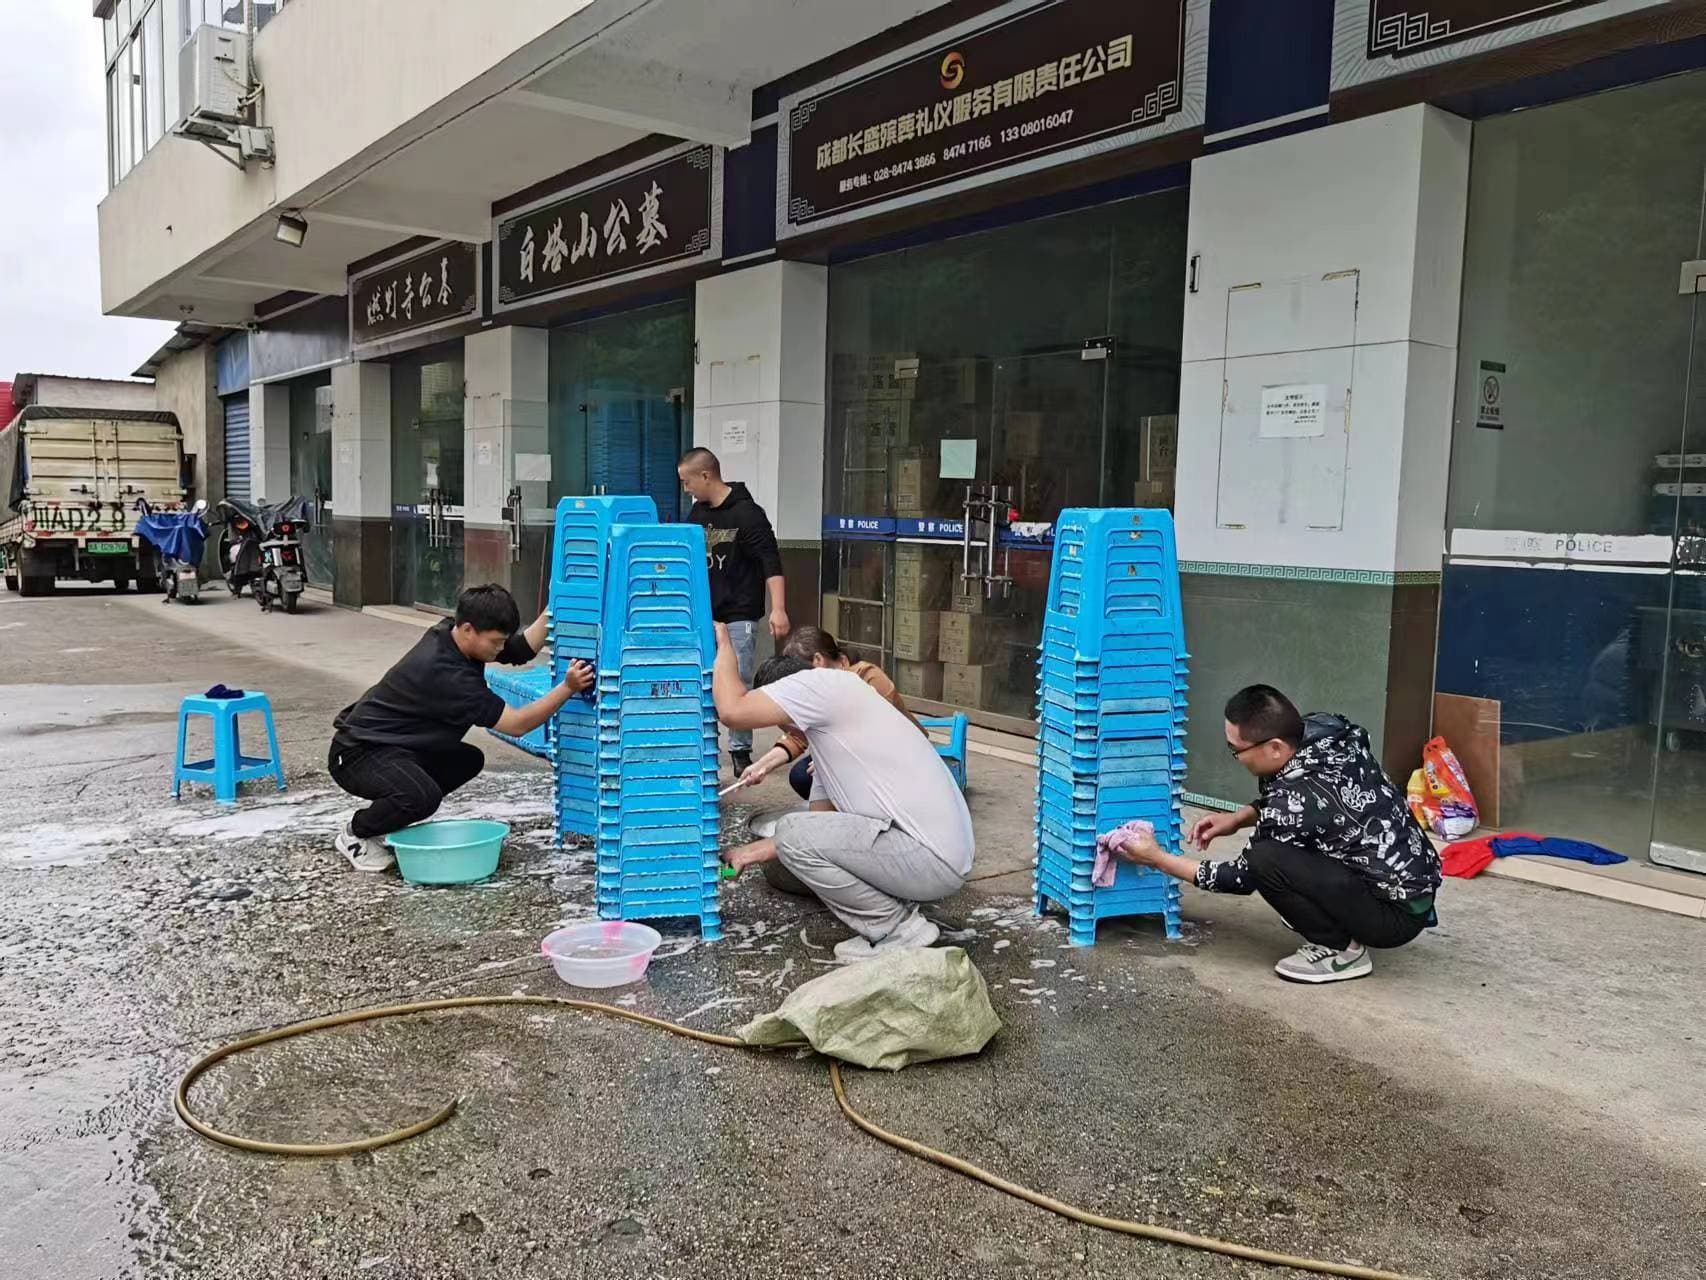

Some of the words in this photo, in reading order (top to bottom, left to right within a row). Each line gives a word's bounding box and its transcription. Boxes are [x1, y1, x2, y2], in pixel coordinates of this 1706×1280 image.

[816, 34, 1133, 171] 成都长盛殡葬礼仪服务有限责任公司
[857, 520, 879, 530] POLICE
[939, 523, 964, 534] POLICE
[1555, 538, 1614, 554] POLICE
